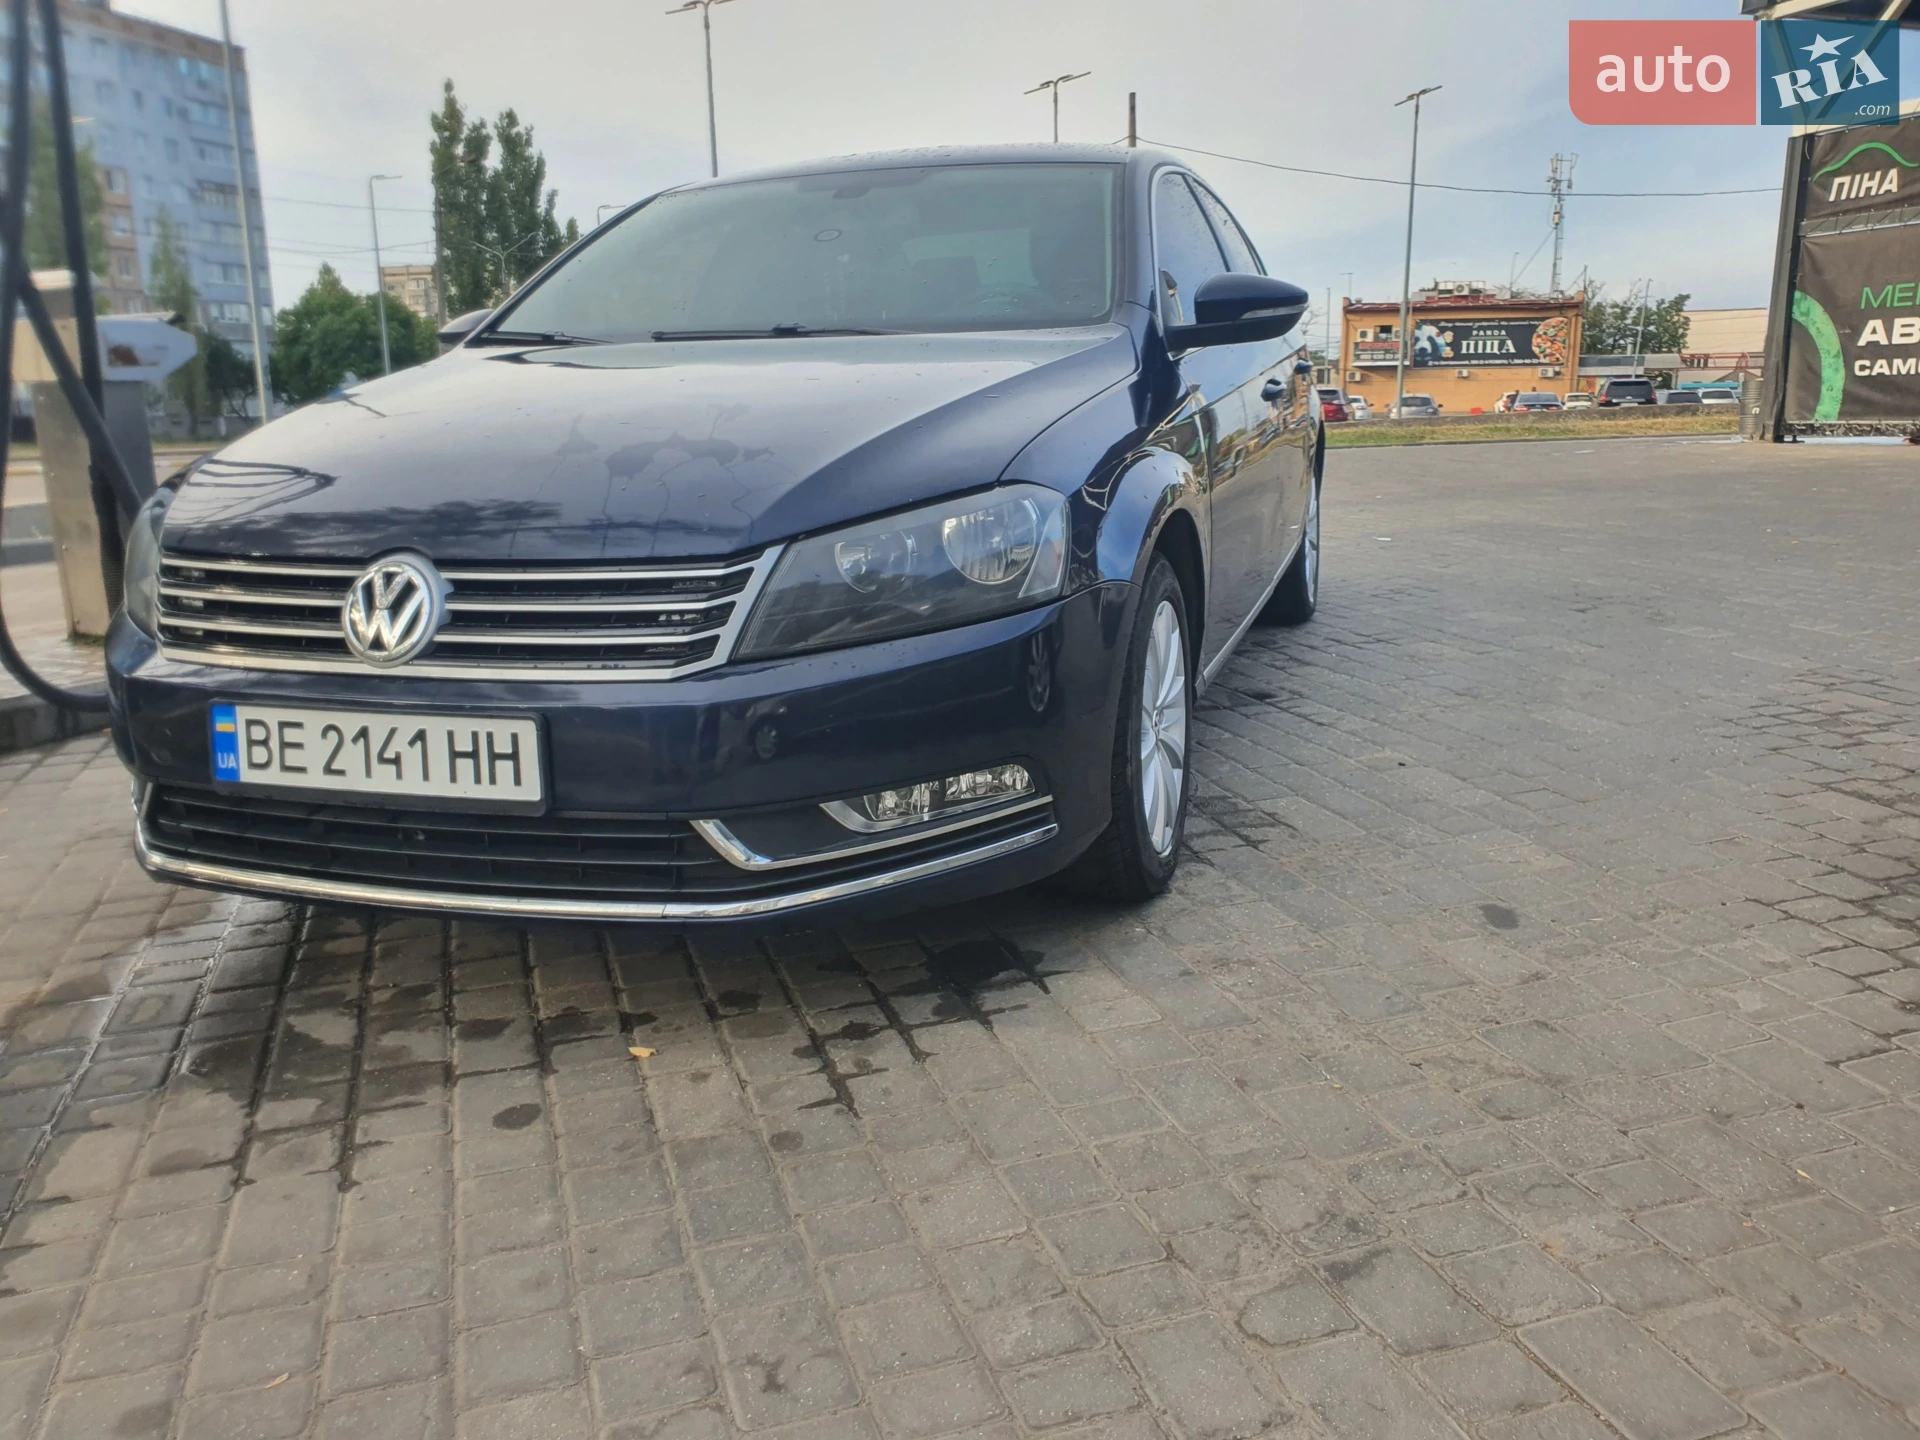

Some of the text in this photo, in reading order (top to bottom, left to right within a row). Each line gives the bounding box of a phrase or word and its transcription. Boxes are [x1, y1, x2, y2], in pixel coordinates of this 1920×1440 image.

[1828, 167, 1899, 202] ПІНА
[1472, 329, 1507, 337] PANDA
[1460, 339, 1516, 355] ПІЦА
[1854, 357, 1920, 377] САМ
[217, 752, 238, 770] UA
[245, 718, 522, 787] BE 2141 HH
